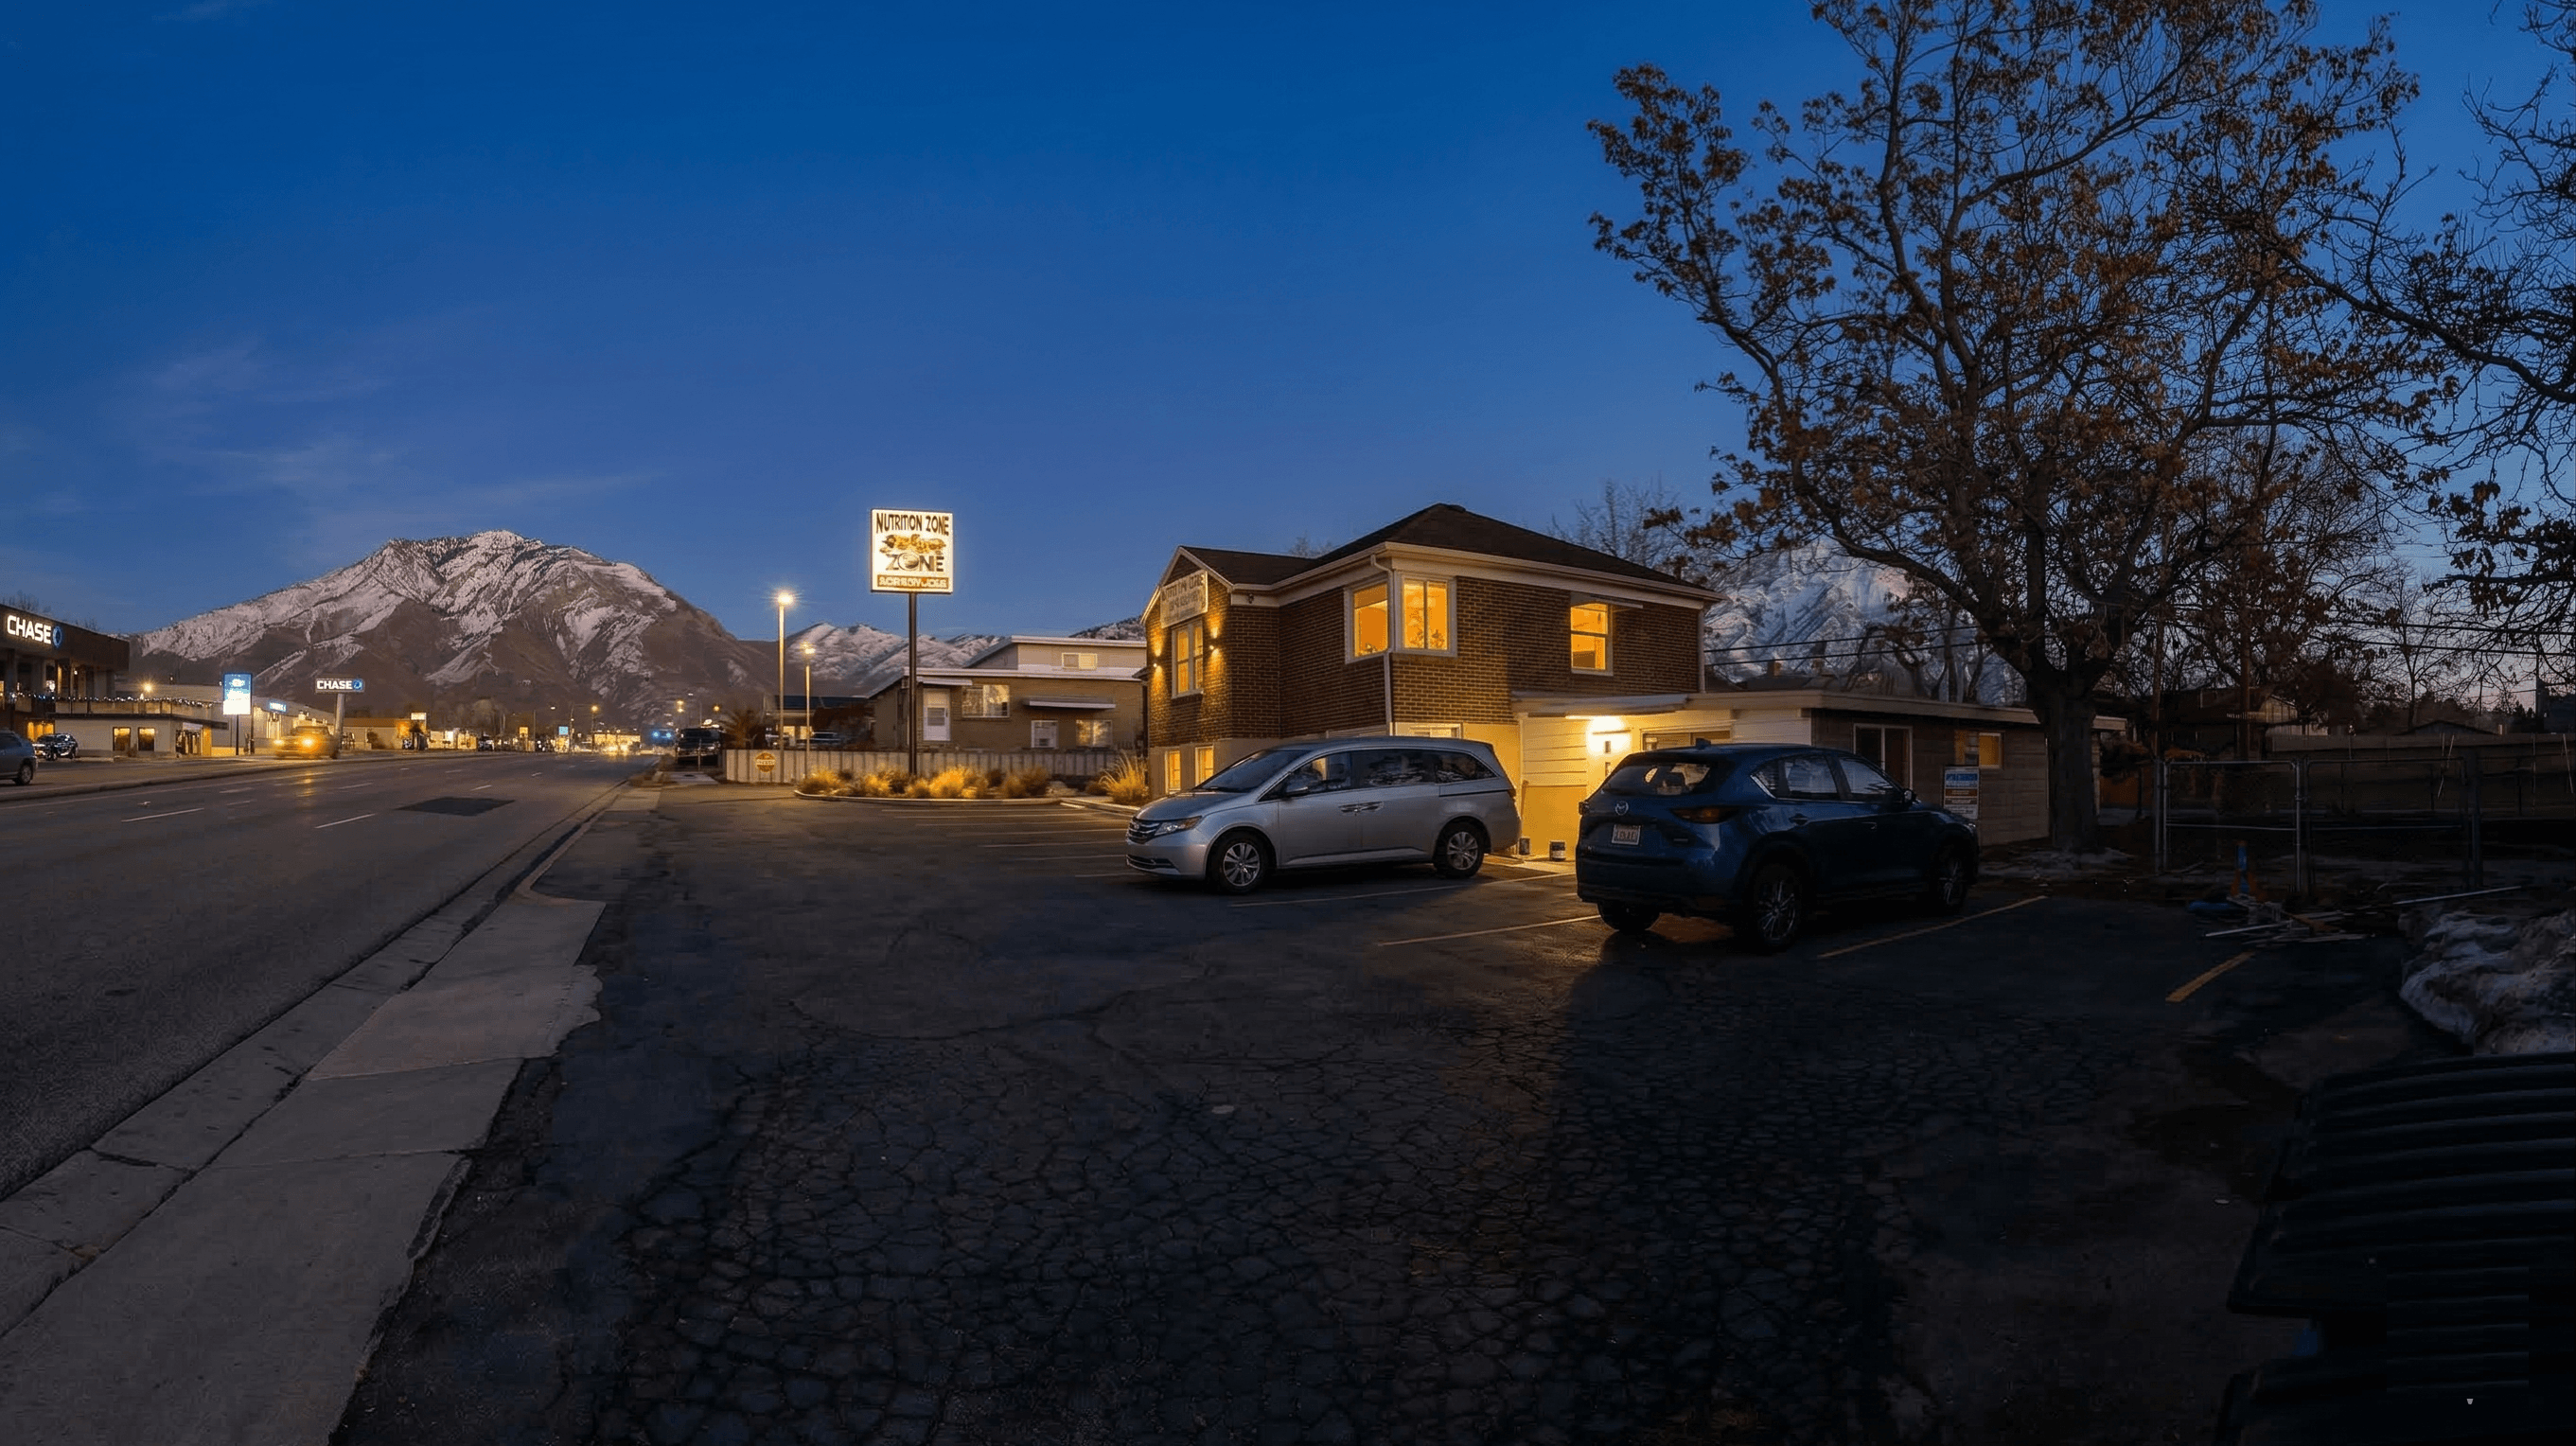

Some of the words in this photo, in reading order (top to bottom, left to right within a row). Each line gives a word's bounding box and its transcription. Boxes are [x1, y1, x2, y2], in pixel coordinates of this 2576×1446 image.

[876, 512, 923, 533] NUTRITION
[926, 515, 949, 536] ZONE
[885, 553, 944, 572] ZONE
[8, 615, 52, 644] CHASE
[317, 679, 353, 690] CHASE
